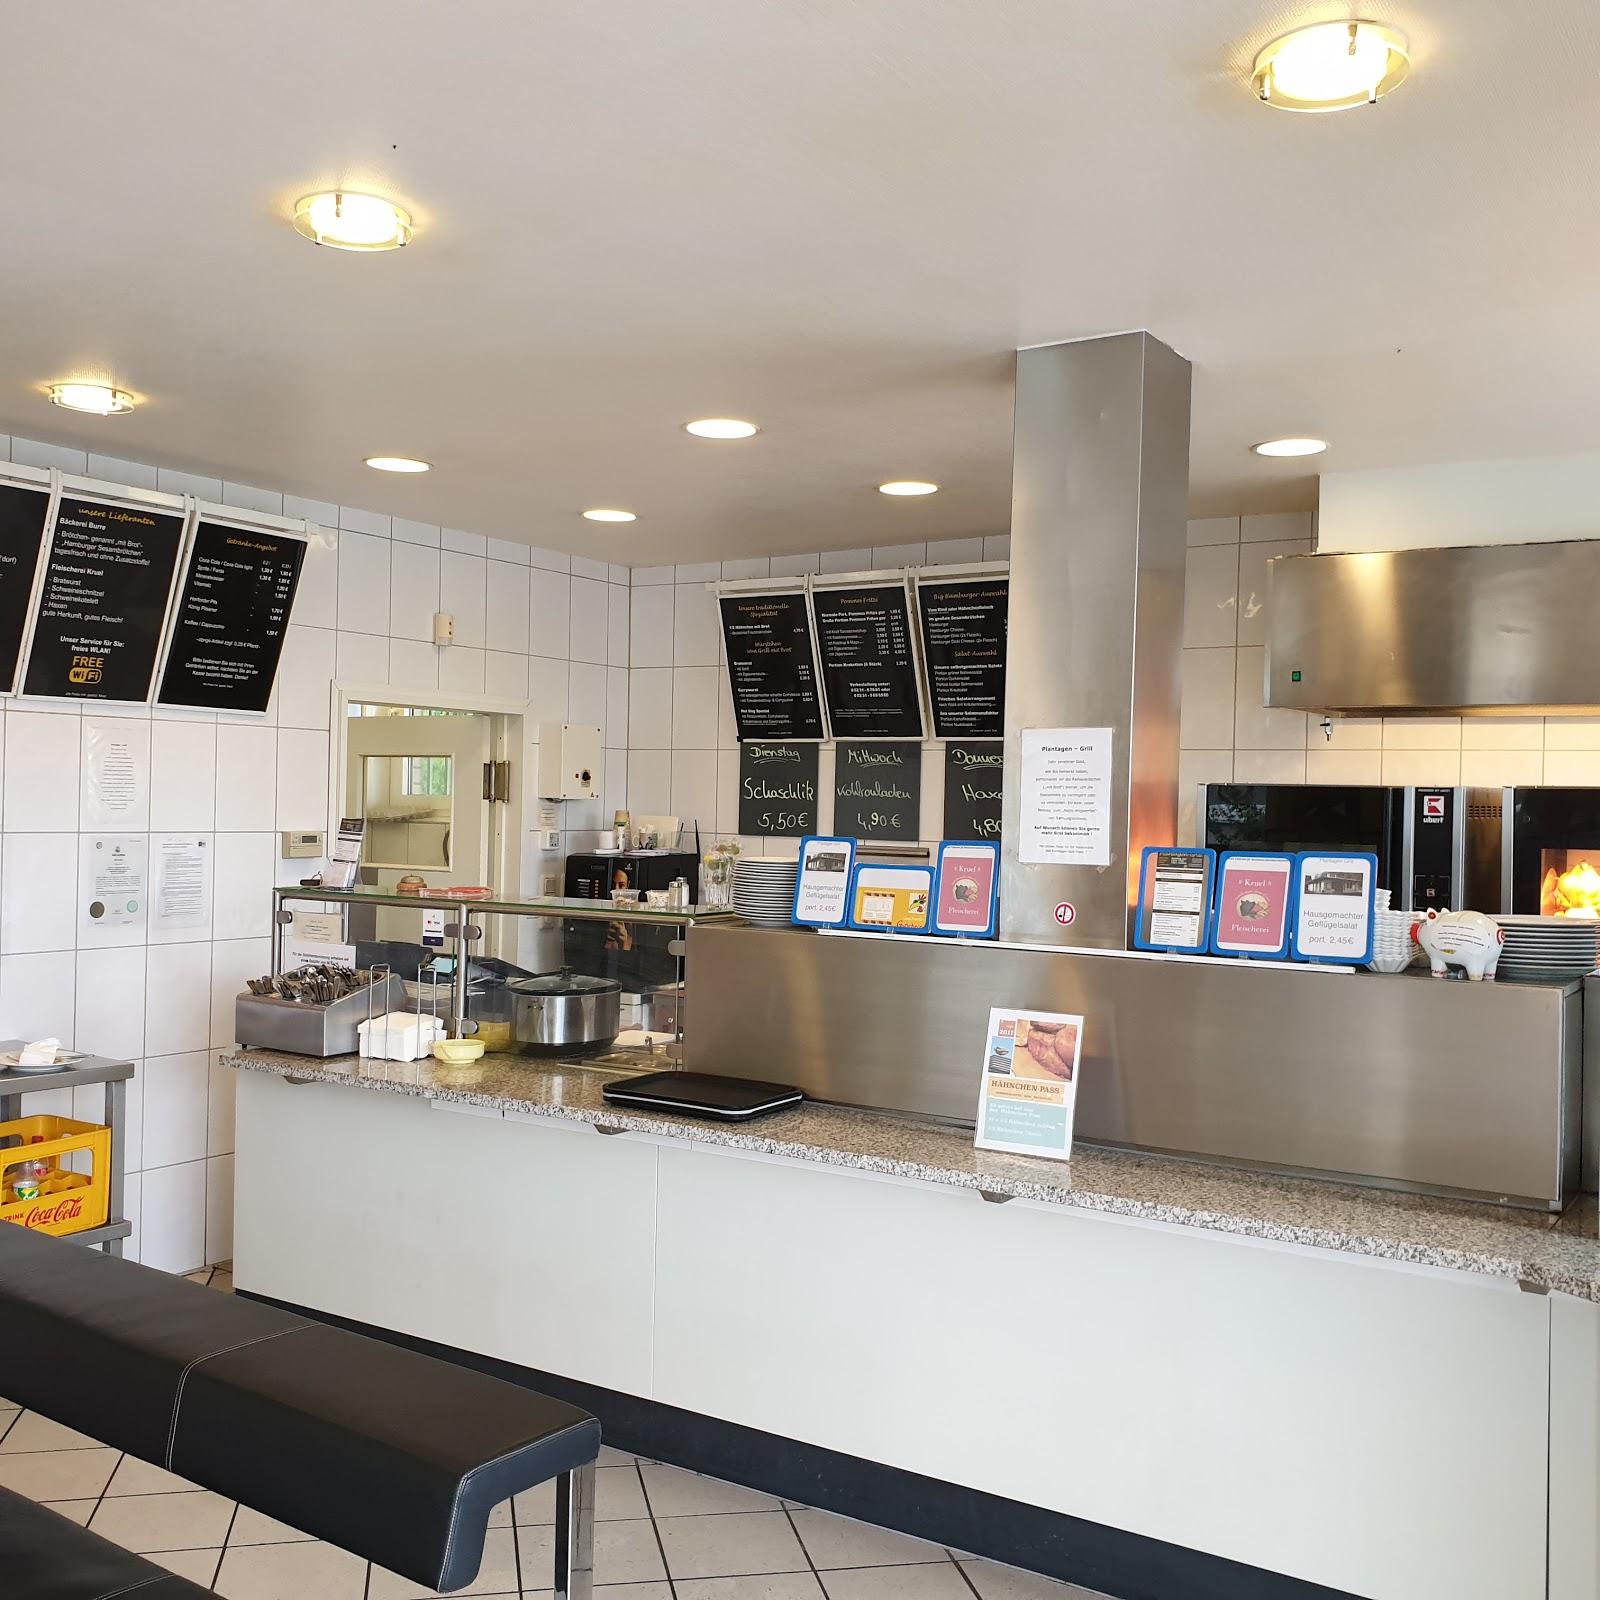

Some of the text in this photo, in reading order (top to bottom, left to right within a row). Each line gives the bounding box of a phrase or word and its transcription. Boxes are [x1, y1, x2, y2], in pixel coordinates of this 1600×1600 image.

[79, 508, 156, 526] unsere Lieferanten
[60, 517, 106, 530] Bäckerei Burre
[99, 553, 114, 561] ohne
[51, 564, 86, 574] Fleischerei
[53, 577, 81, 586] Bratwurst
[48, 601, 68, 610] Haxen
[84, 614, 101, 622] gutes
[80, 637, 102, 645] Service
[72, 656, 104, 668] FREE
[750, 745, 801, 761] Dienstag
[848, 749, 903, 764] Mittwoch
[743, 777, 814, 801] Schaschlik
[803, 883, 844, 892] Hausgemachter
[1244, 879, 1266, 887] Kruel
[1303, 910, 1364, 920] Hausgemachter
[1231, 924, 1269, 934] Fleischerei
[1308, 920, 1358, 930] Geflügelsalat
[1329, 936, 1354, 945] 2,45€
[24, 1196, 84, 1228] Coca-Cola
